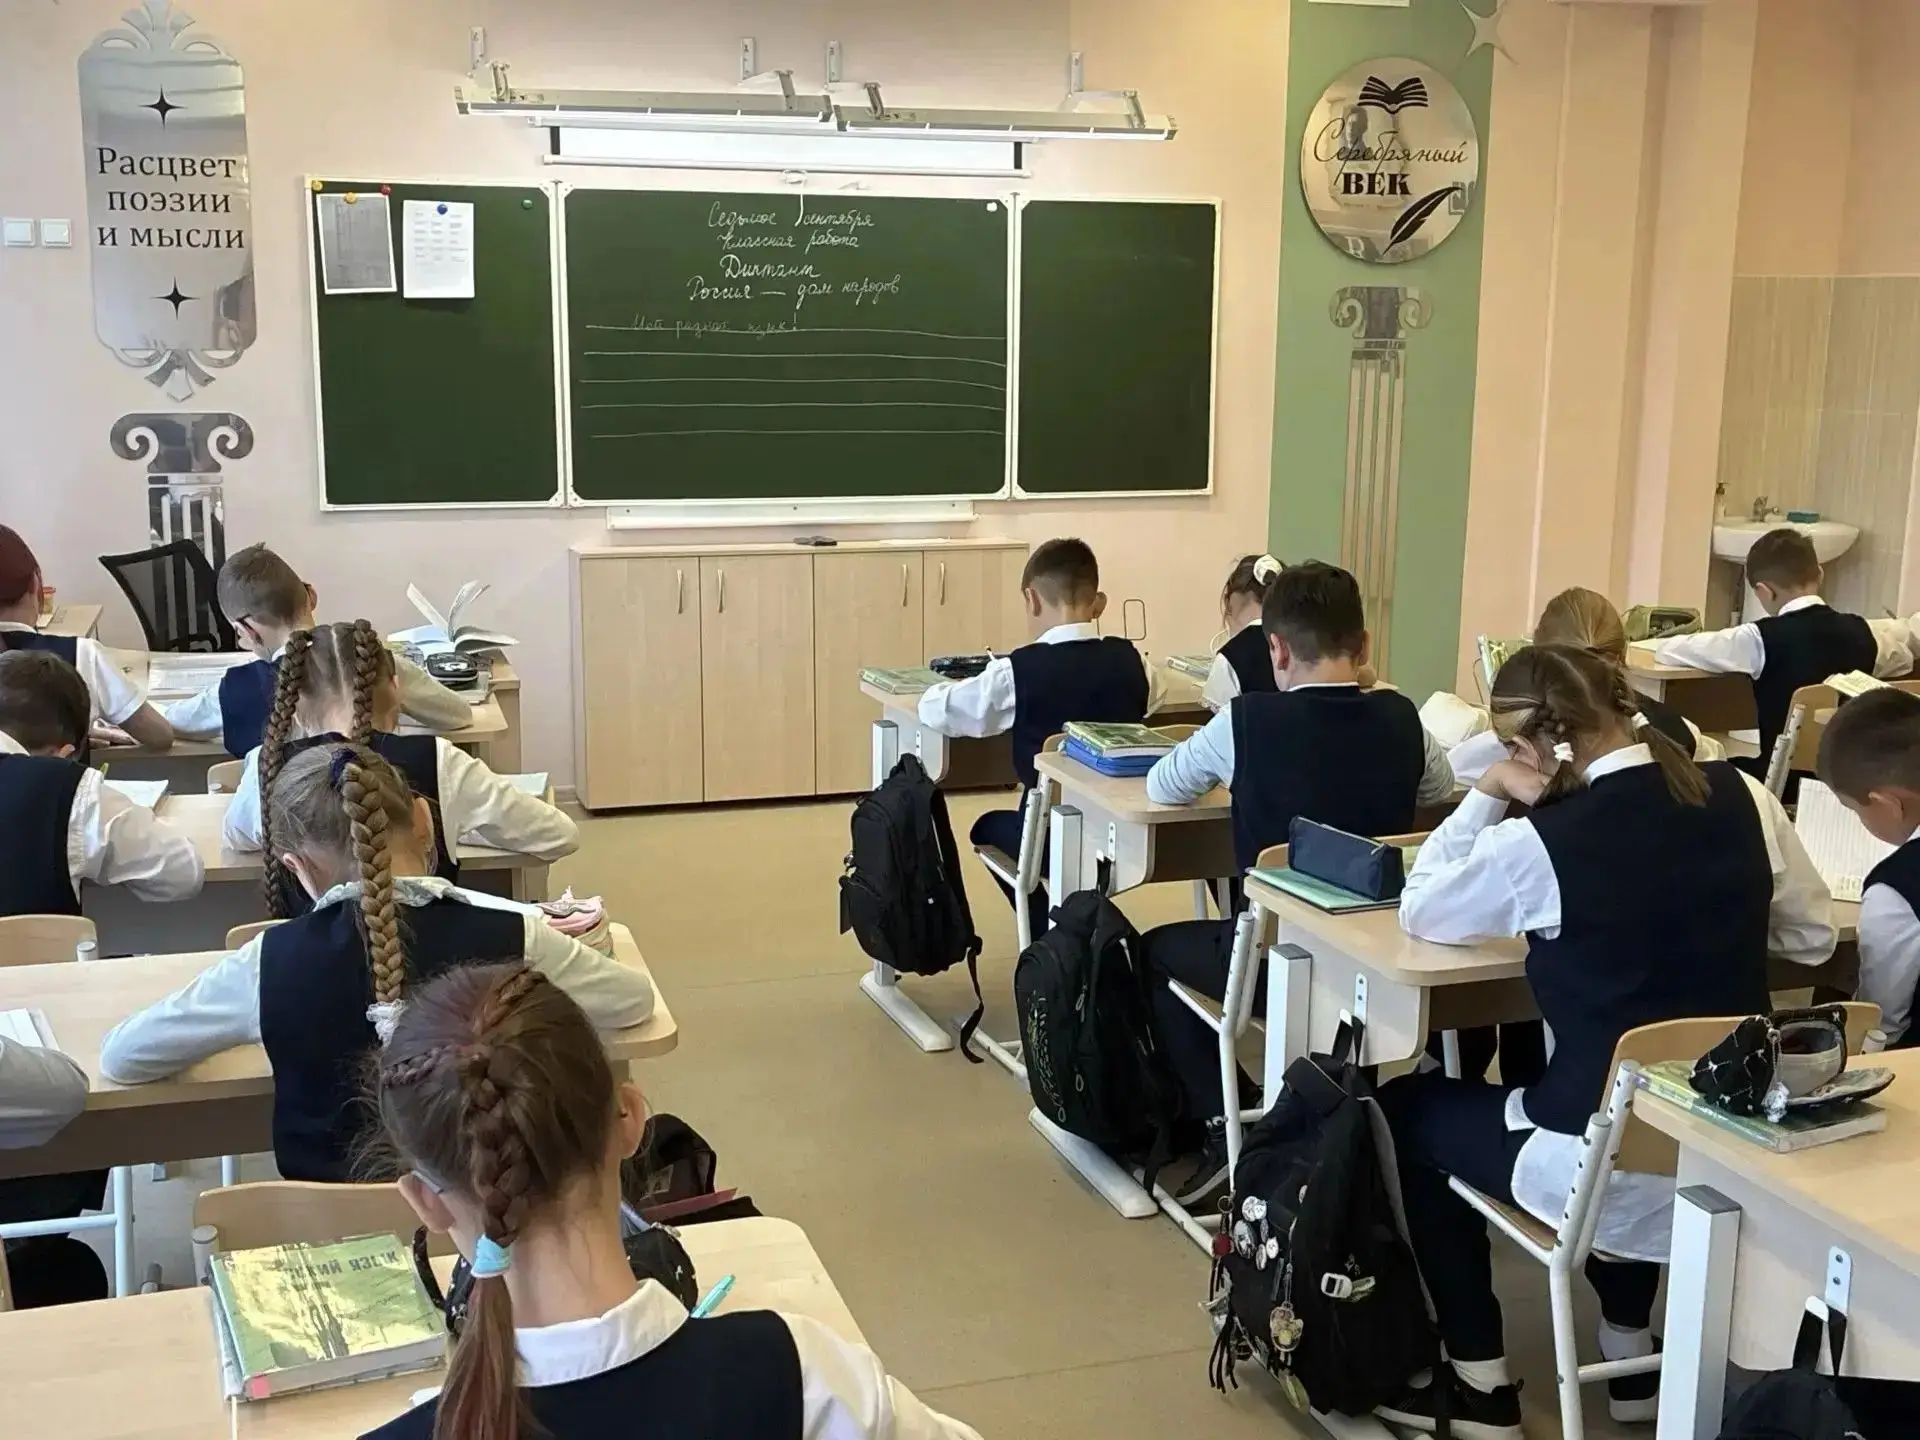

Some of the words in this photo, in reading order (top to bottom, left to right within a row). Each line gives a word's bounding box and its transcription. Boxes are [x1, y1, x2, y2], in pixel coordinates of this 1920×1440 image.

[97, 147, 236, 182] Расцвет
[1313, 117, 1468, 186] Серебряный
[1341, 171, 1412, 196] ВЕК
[107, 191, 231, 213] поэзии
[97, 226, 118, 247] и
[129, 227, 245, 249] мысли
[804, 228, 860, 255] работа
[686, 275, 754, 300] Россия
[796, 285, 834, 310] дом
[841, 274, 901, 305] народов
